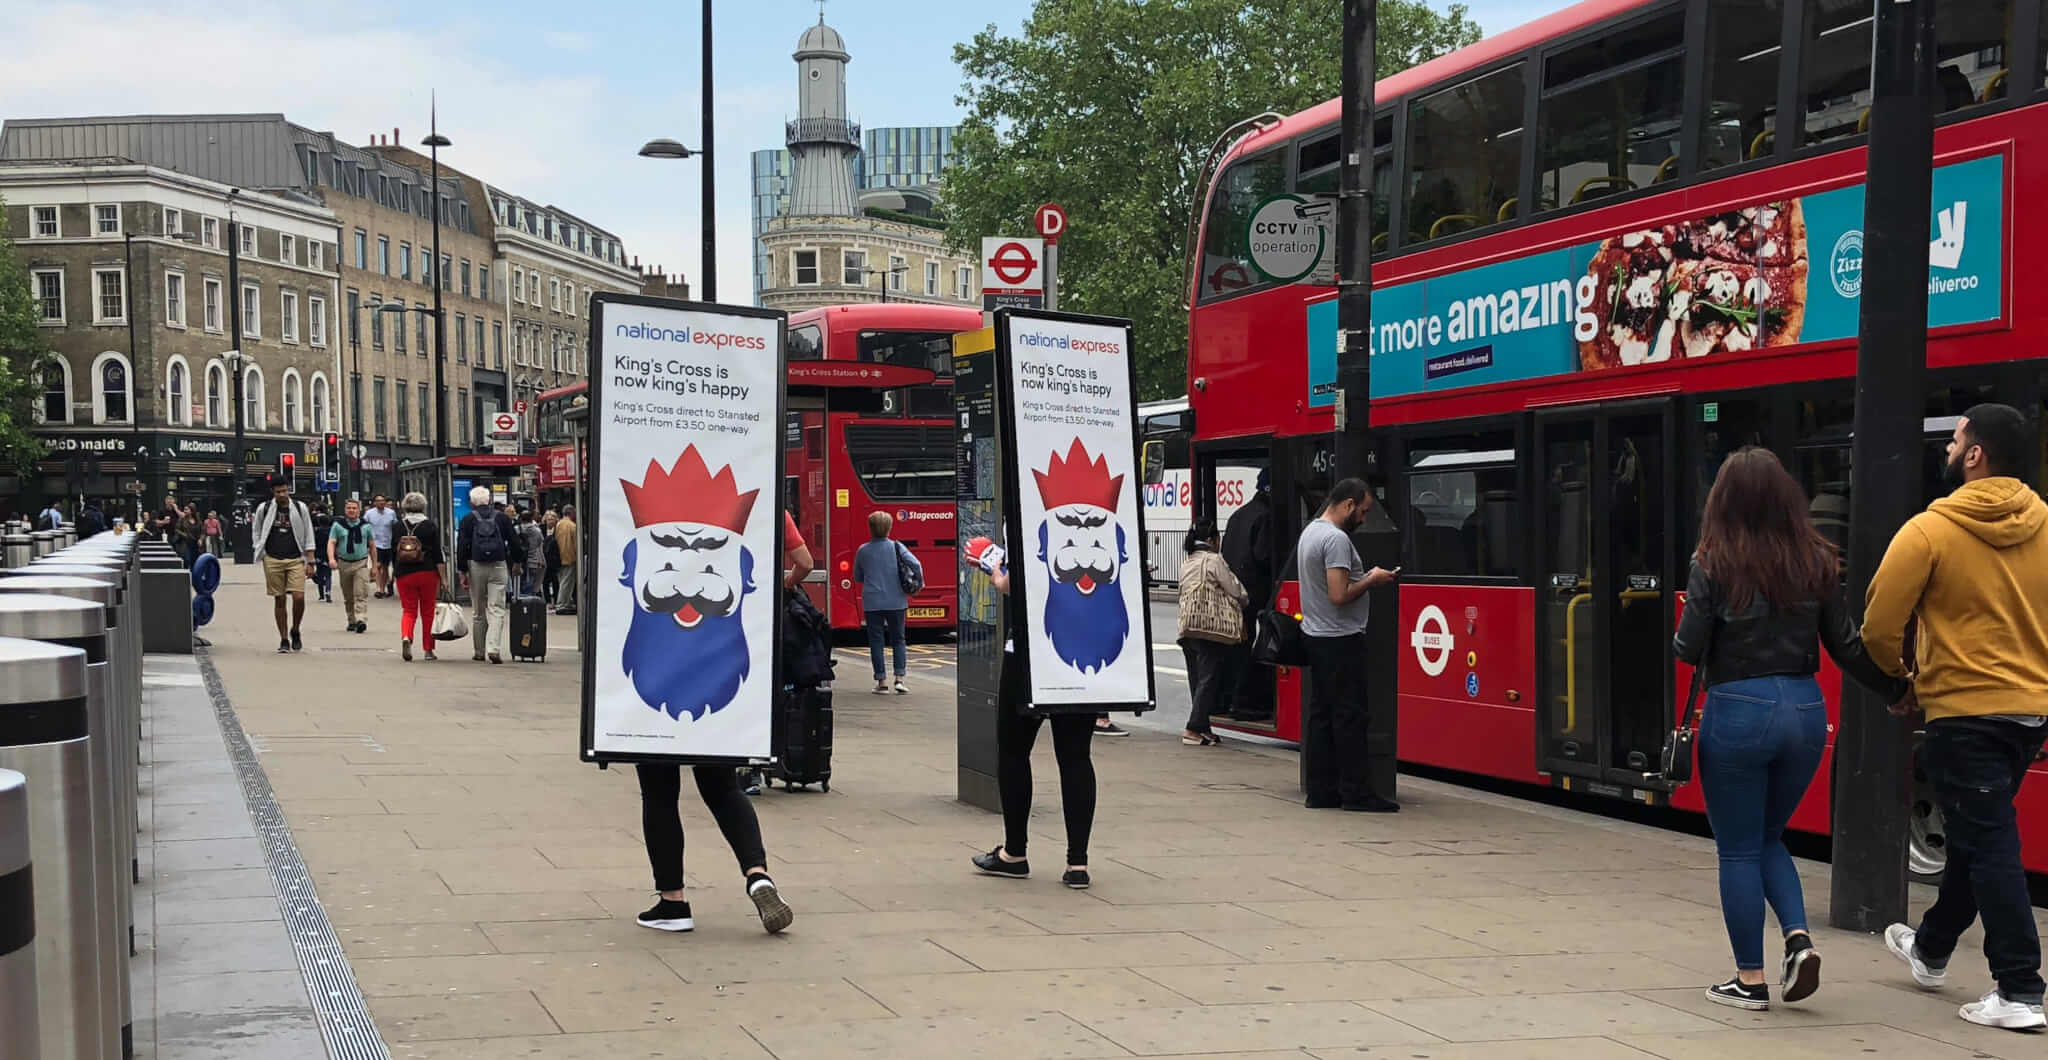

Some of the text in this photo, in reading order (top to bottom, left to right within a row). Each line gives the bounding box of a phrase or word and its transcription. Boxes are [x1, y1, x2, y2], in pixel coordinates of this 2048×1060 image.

[1043, 209, 1063, 234] D
[1255, 222, 1315, 235] CCTV in
[1253, 240, 1316, 254] operation
[1837, 257, 1863, 274] Zizz
[1928, 275, 1978, 295] eliveroo
[1380, 314, 1442, 354] more
[1447, 272, 1599, 343] amazing
[616, 322, 766, 350] national express
[1019, 332, 1120, 355] national express
[614, 355, 729, 379] King's Cross is
[788, 367, 858, 377] King's Cross Station
[1020, 360, 1098, 380] King's Cross is
[614, 375, 750, 400] now king's happy
[1021, 378, 1112, 398] now king's happy
[517, 401, 524, 412] E
[613, 400, 760, 422] King's Cross direct to Stansted
[1022, 400, 1121, 417] King's Cross direct to Stansted
[613, 414, 647, 427] Airport
[650, 416, 673, 428] from
[707, 423, 750, 436] one-way
[1023, 412, 1047, 423] Airport
[1048, 413, 1064, 423] from
[179, 439, 226, 454] McDonald's
[1312, 450, 1327, 472] 45
[909, 511, 954, 522] Stagecoach
